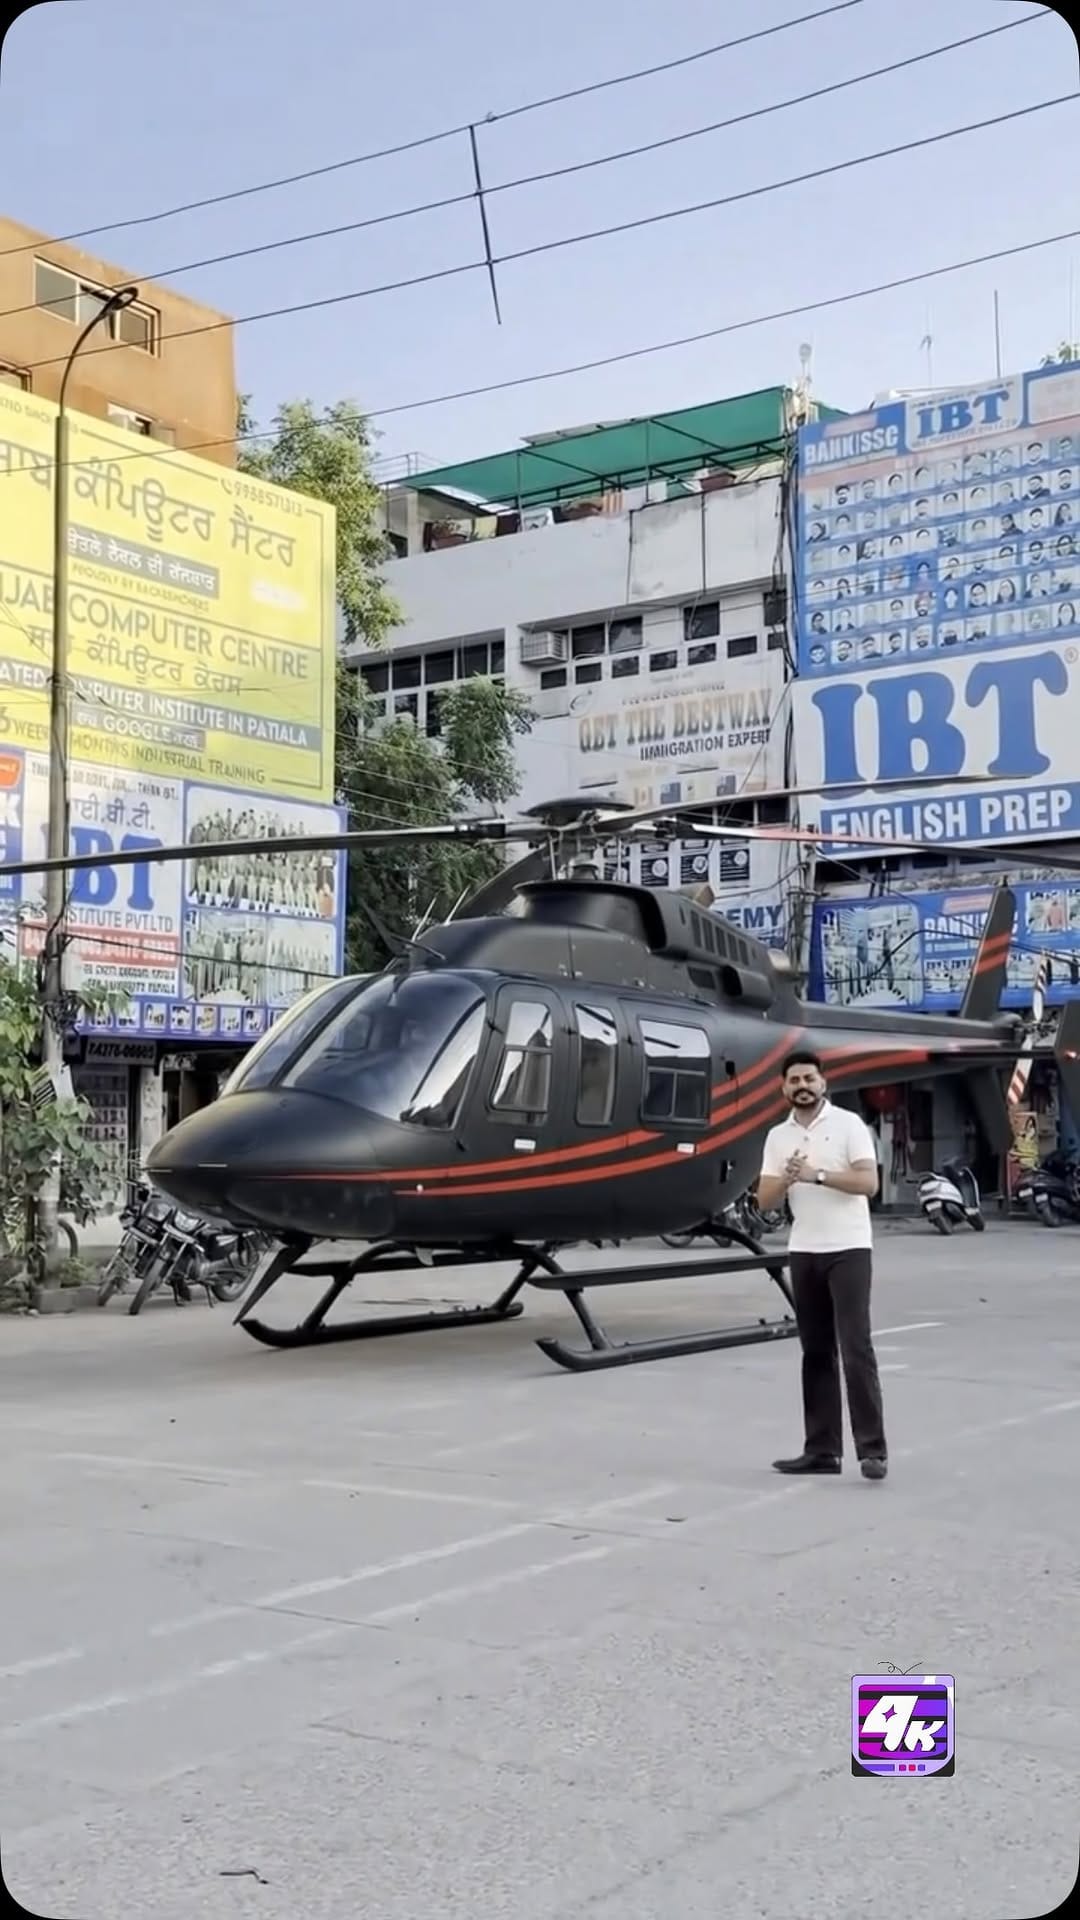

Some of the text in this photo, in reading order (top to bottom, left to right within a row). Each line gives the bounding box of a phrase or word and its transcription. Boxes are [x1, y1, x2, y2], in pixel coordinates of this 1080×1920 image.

[917, 390, 1009, 438] IBT
[0, 572, 54, 614] JAB
[68, 593, 213, 657] COMPUTER
[220, 635, 308, 679] CENTRE
[103, 714, 172, 742] GOOGLE
[149, 695, 224, 729] INSTITUTE
[228, 712, 243, 734] IN
[248, 717, 308, 747] PATIALA
[625, 703, 665, 746] THE
[728, 728, 771, 749] EXPERT
[812, 650, 1068, 800] IBT
[208, 758, 265, 784] TRAINING
[831, 789, 1072, 848] ENGLISH PREP
[41, 822, 163, 911] BT
[69, 907, 121, 928] STITUTE
[714, 905, 782, 929] EMY
